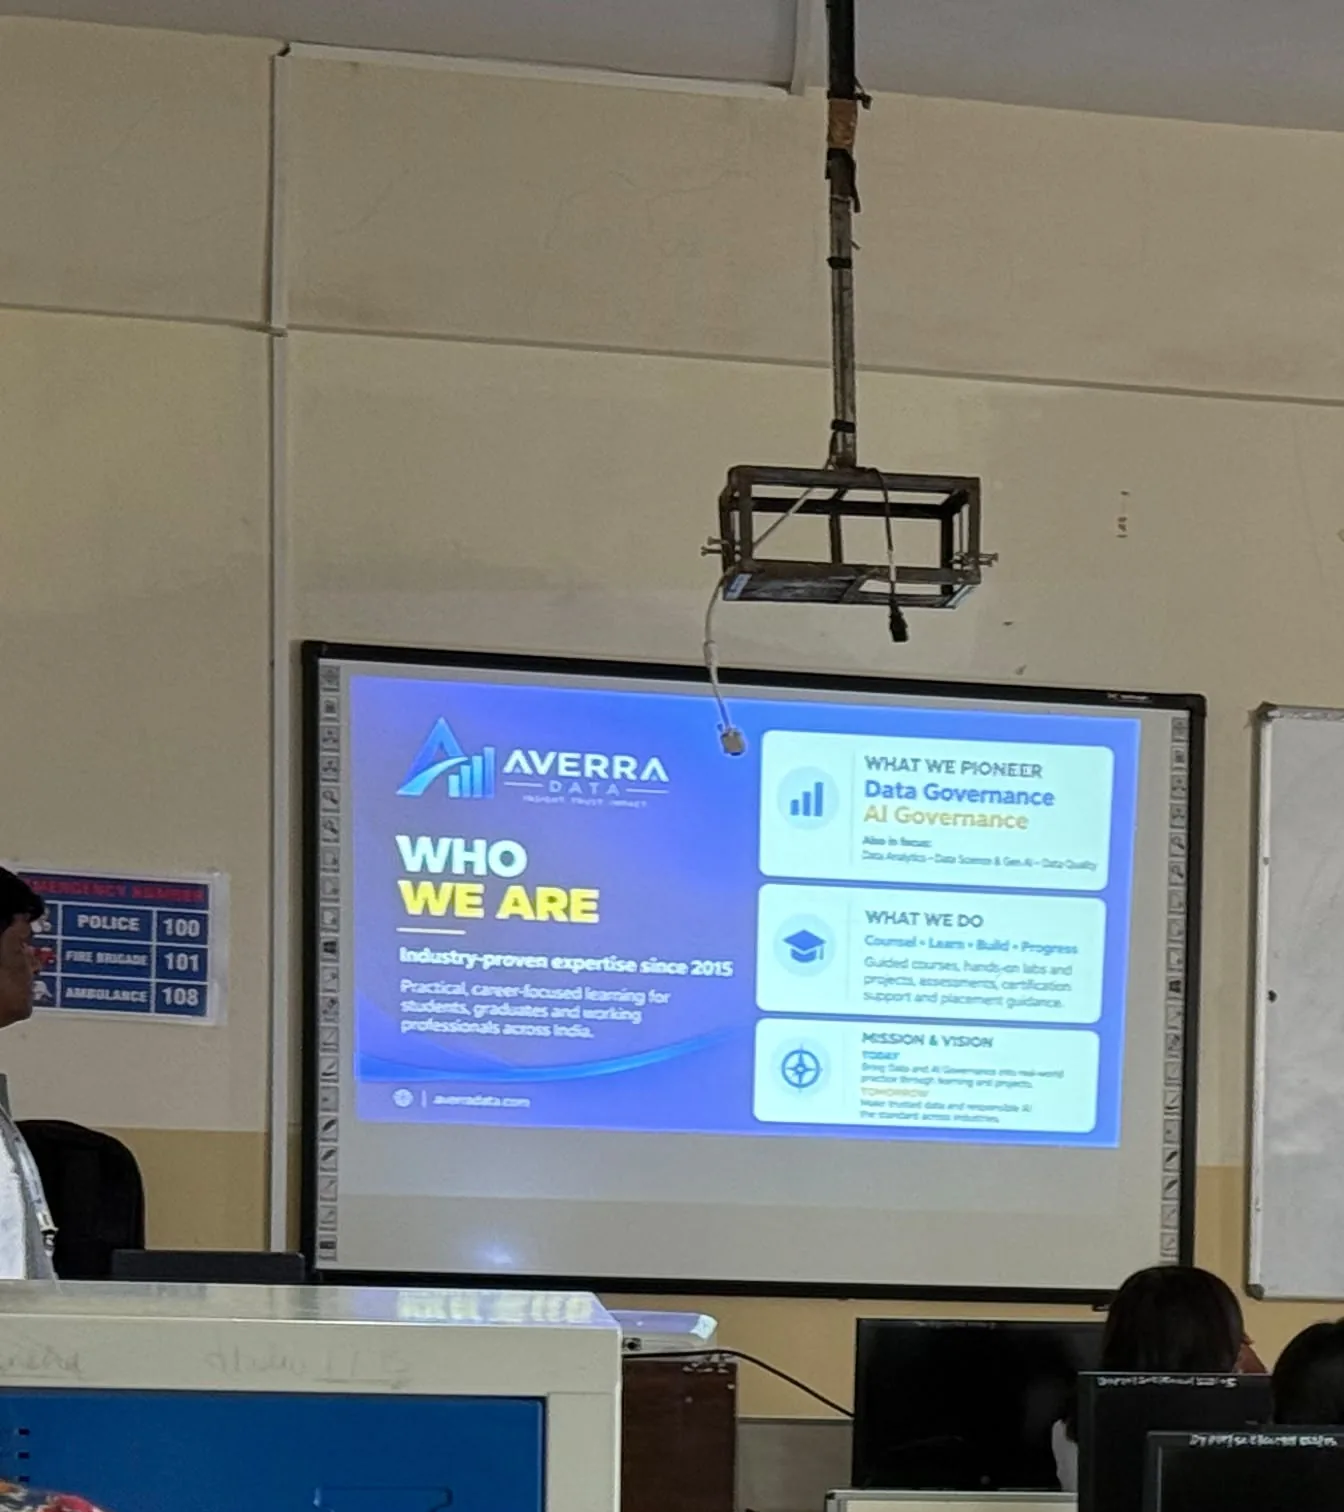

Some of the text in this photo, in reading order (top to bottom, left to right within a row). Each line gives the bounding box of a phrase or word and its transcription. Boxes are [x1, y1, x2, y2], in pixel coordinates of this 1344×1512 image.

[503, 749, 670, 782] AVERRA
[864, 755, 1043, 779] WHAT WE PIONEER
[549, 780, 620, 797] DATA
[864, 779, 1055, 806] Data Governance
[863, 804, 1030, 829] AI Governance
[395, 835, 528, 877] WHO
[397, 880, 600, 924] WE ARE
[77, 914, 201, 938] POLICE 100
[865, 910, 984, 928] WHAT WE DO
[1021, 941, 1079, 956] Progress
[65, 951, 93, 963] FIRE
[164, 952, 200, 973] 101
[400, 947, 734, 977] Industry-proven expertise since 2015
[162, 987, 200, 1006] 108
[648, 989, 672, 1003] for
[551, 1004, 580, 1019] and
[862, 1032, 925, 1045] MISSION
[940, 1035, 994, 1048] VISION
